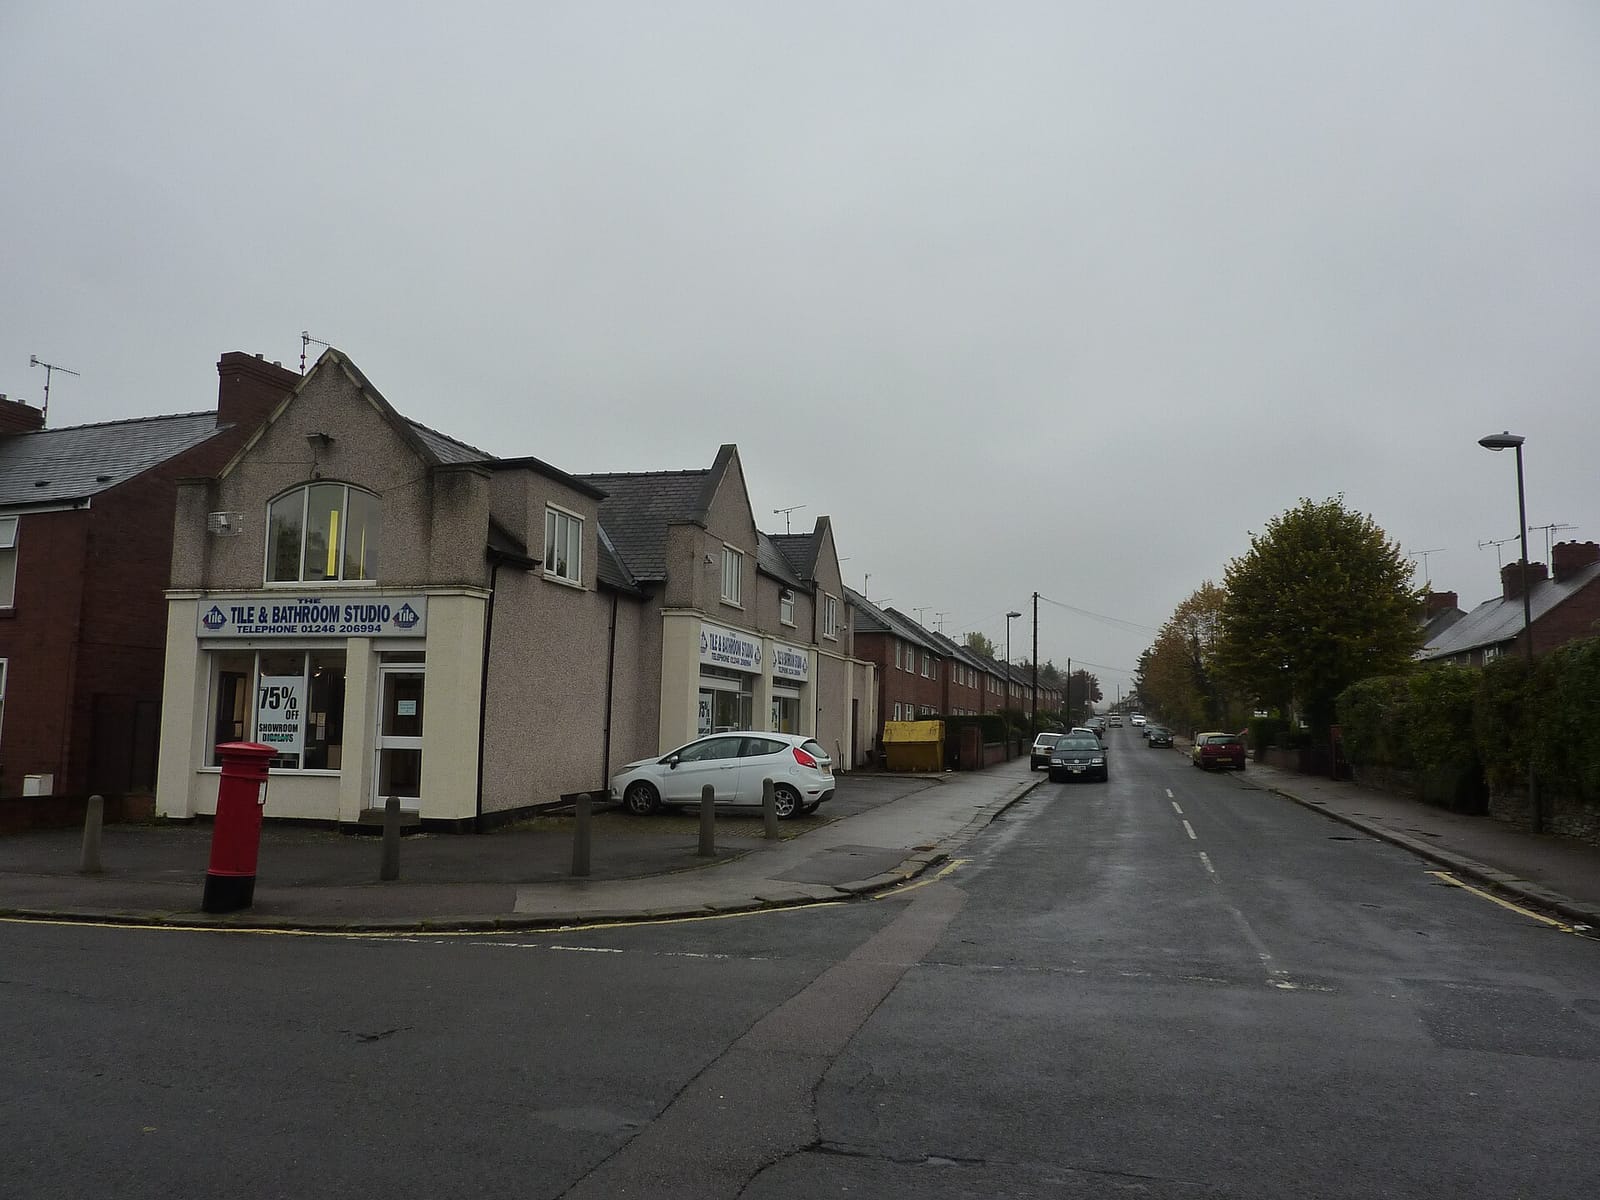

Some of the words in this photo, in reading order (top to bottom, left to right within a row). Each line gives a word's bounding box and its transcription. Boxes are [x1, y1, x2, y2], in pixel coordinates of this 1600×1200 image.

[230, 606, 255, 624] TILE
[258, 606, 268, 624] &
[272, 605, 340, 624] BATHROOM
[343, 604, 391, 623] STUDIO
[237, 625, 298, 634] TELEPHONE
[301, 624, 336, 633] 01246
[339, 624, 382, 633] 206994
[259, 686, 297, 710] 75%
[285, 709, 299, 720] OFF
[258, 723, 299, 733] SHOWROOM
